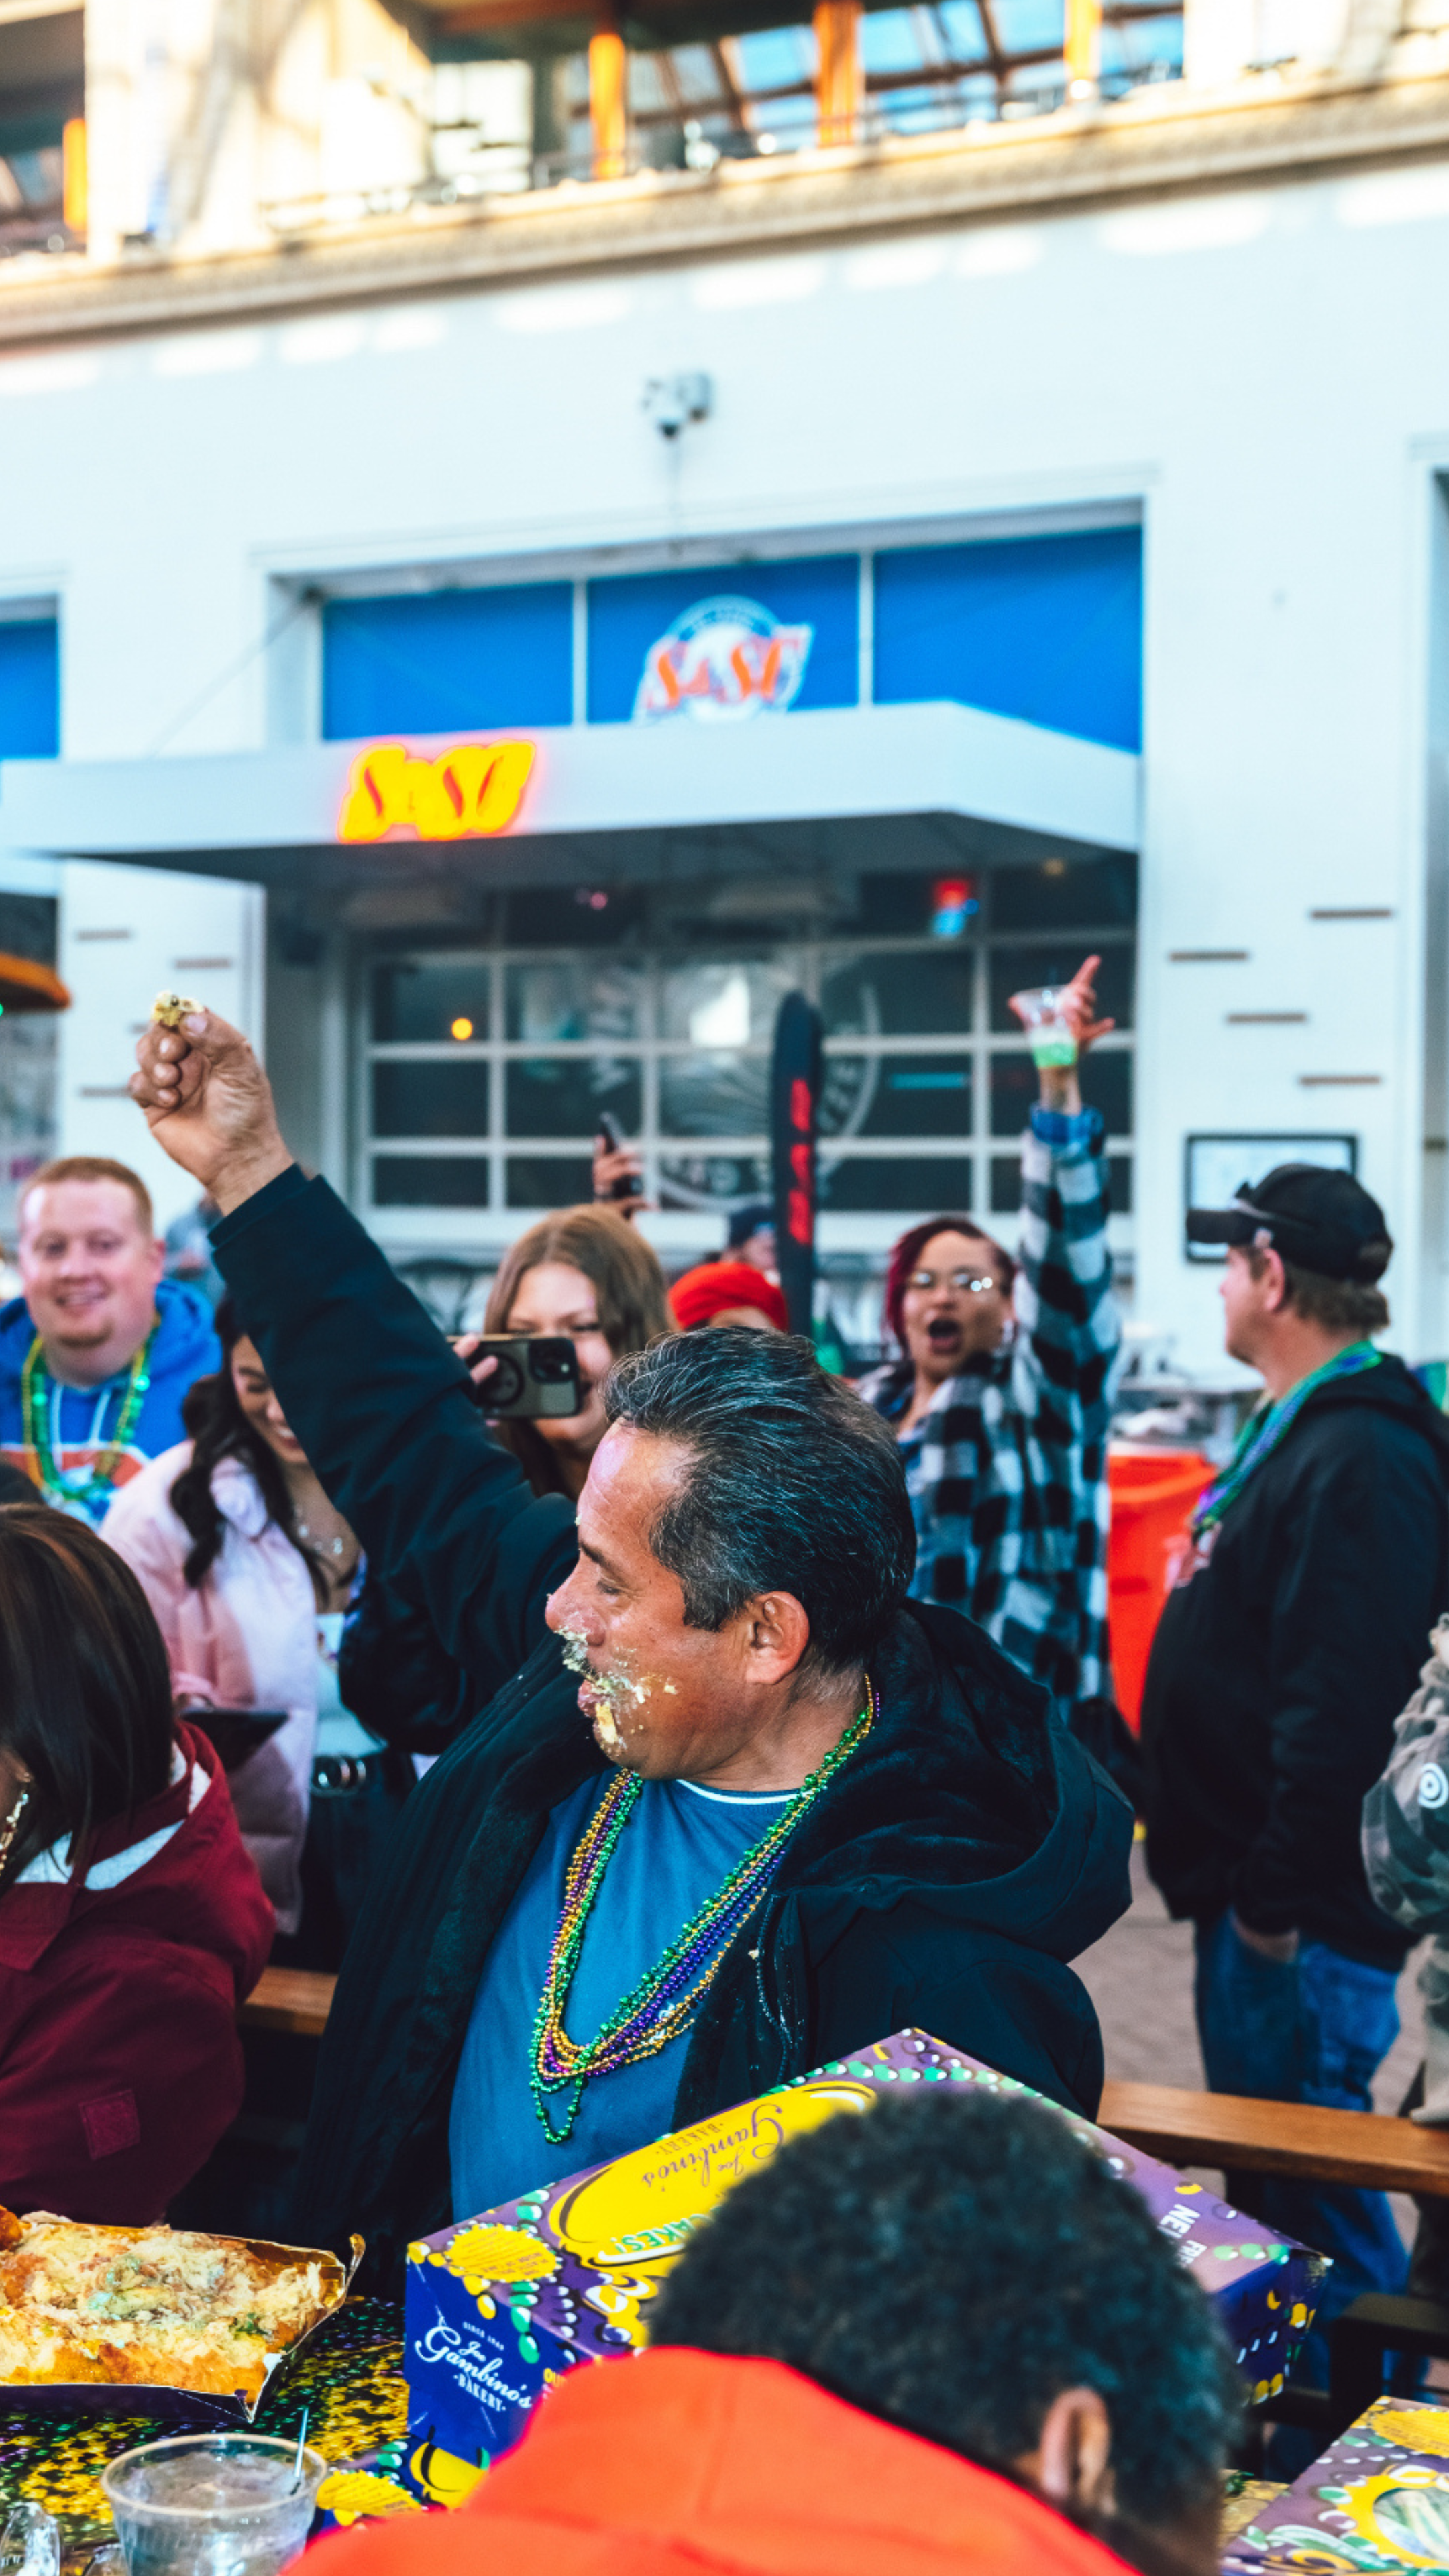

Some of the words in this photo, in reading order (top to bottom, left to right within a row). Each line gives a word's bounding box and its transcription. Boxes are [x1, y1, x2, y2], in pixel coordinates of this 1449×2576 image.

[642, 2103, 784, 2192] Gambino's
[717, 2146, 745, 2176] Joe
[415, 2326, 532, 2408] Gambino's
[458, 2341, 486, 2362] Joe
